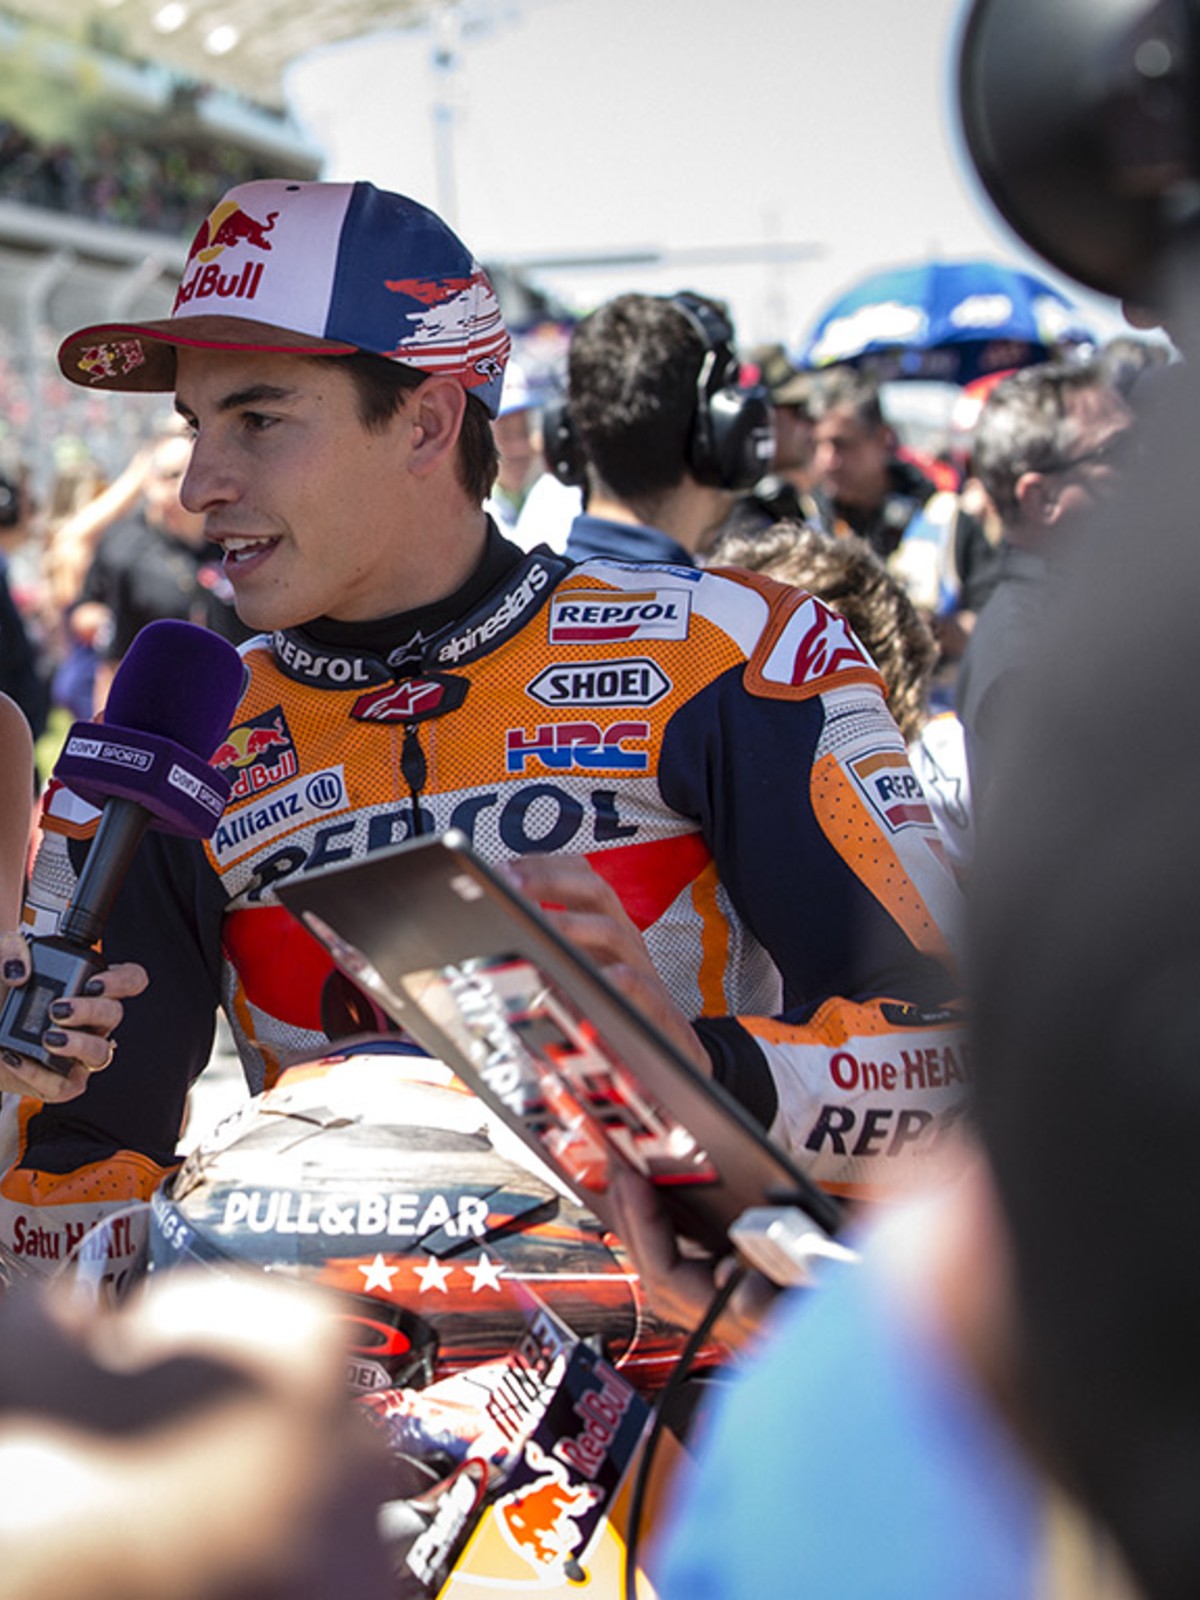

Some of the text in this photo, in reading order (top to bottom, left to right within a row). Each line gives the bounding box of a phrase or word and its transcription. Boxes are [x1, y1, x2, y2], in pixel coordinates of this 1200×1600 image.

[438, 563, 549, 665] alpinestars
[557, 603, 679, 624] REPSOL
[274, 634, 369, 682] REPSOL
[549, 669, 650, 699] SHOEI
[102, 746, 148, 768] SPORTS
[506, 721, 650, 772] HRC
[215, 793, 304, 856] Allianz
[829, 1046, 969, 1091] One HEA
[223, 1191, 489, 1237] PULL&BEAR
[13, 1215, 60, 1260] Satu
[345, 1364, 377, 1388] OEI
